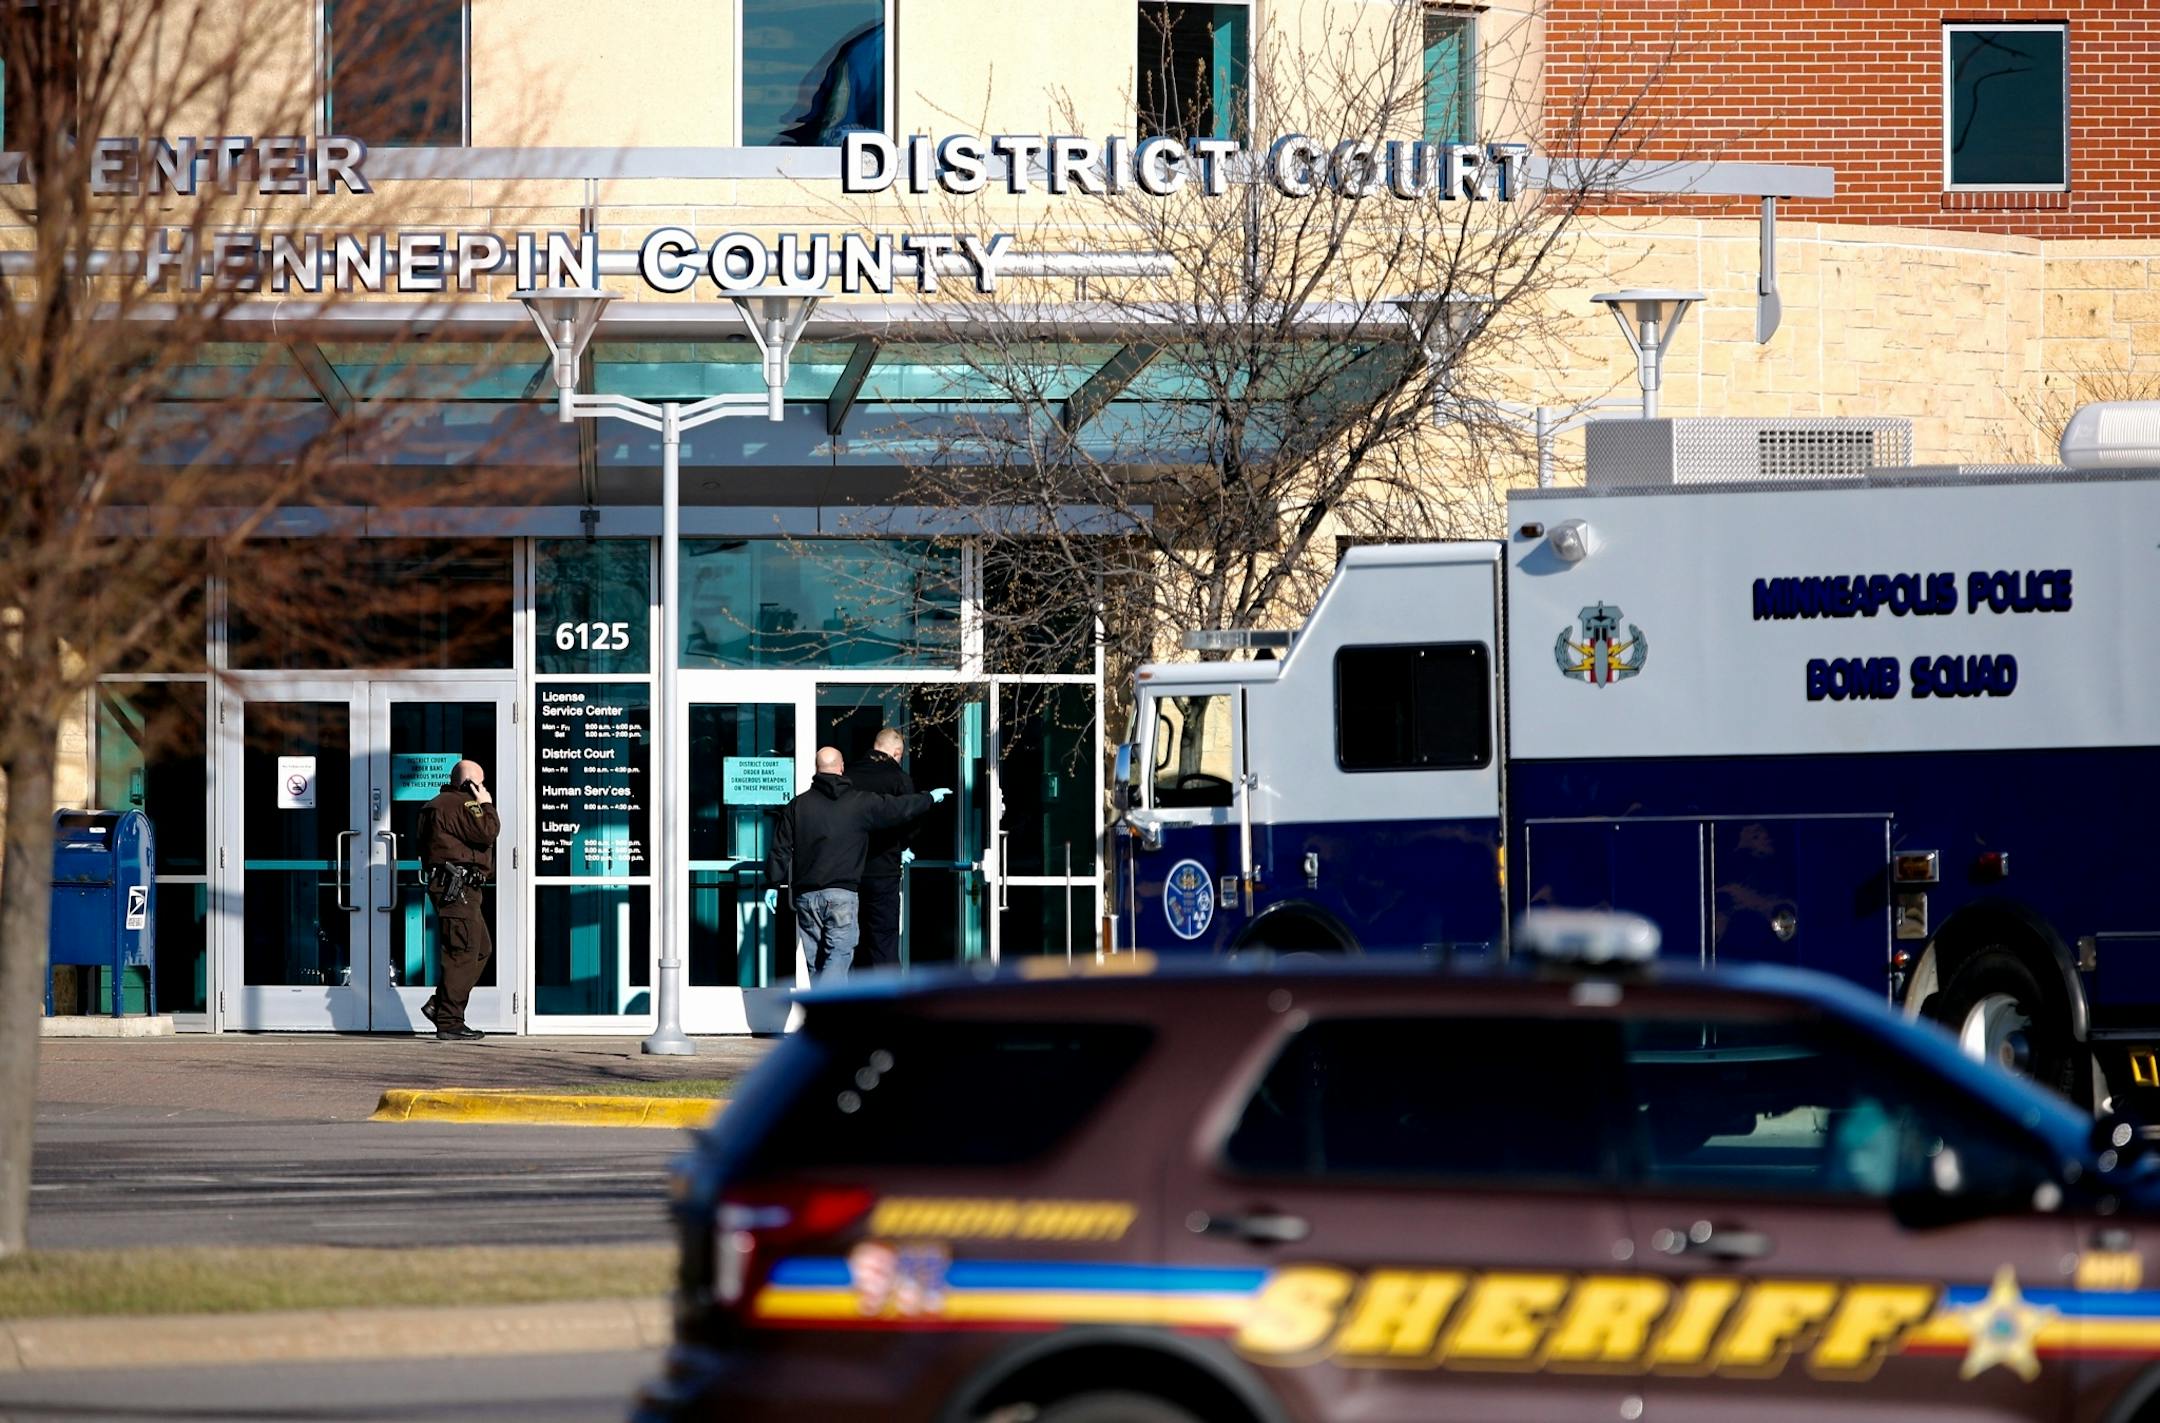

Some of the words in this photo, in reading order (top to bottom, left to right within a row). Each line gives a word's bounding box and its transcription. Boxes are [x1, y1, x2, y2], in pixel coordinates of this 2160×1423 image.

[19, 134, 373, 196] ENTER
[842, 130, 1239, 196] DISTRICT
[1268, 132, 1533, 202] COURT
[145, 227, 599, 293] HENNEPIN
[639, 227, 1014, 293] COUNTY
[1753, 572, 1958, 621] MINNEAPOLIS
[1968, 569, 2073, 614] POLICE
[555, 622, 630, 651] 6125
[542, 691, 585, 702] License
[1806, 657, 1900, 701] BOMB
[1910, 654, 2018, 699] SQUAD
[542, 705, 583, 716] Service
[586, 705, 623, 716] Center
[542, 748, 581, 759] District
[584, 748, 615, 759] Court
[542, 785, 581, 796] Human
[584, 785, 631, 796] Servces
[542, 822, 580, 834] Library
[1238, 1266, 1937, 1380] SHERIFF
